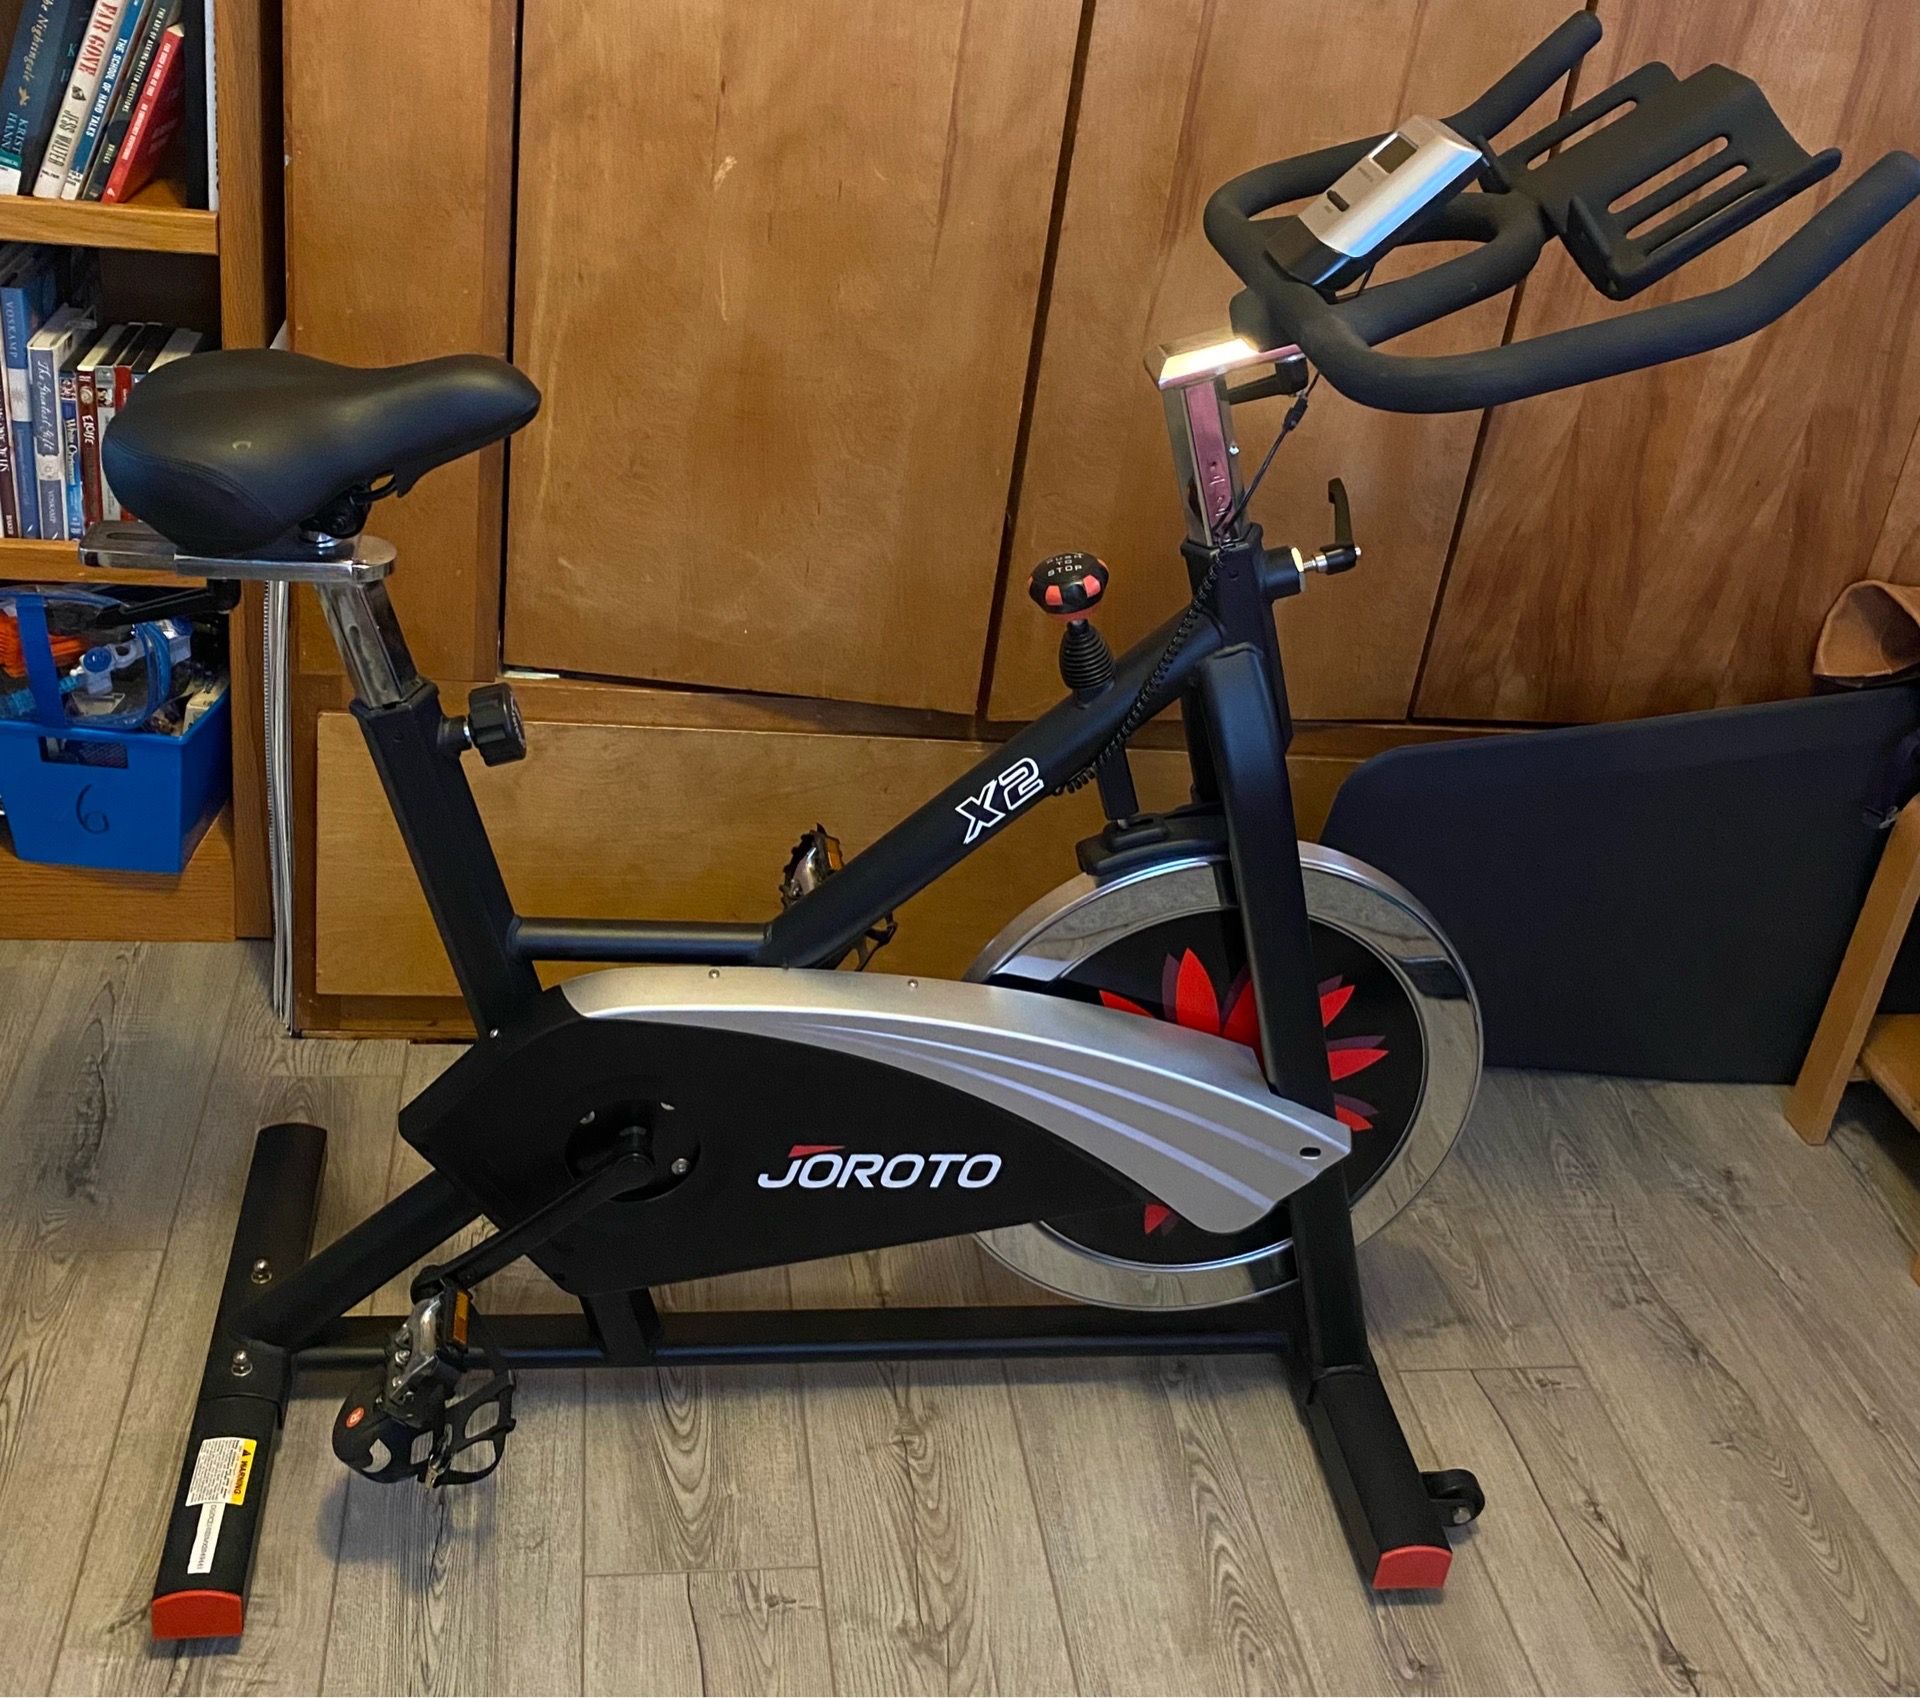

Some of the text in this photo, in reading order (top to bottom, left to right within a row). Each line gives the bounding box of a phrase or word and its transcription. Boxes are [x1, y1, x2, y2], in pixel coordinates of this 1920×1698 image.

[23, 13, 48, 82] Nightingale
[78, 2, 118, 76] FAR GONE
[141, 40, 154, 60] ASKING
[85, 37, 128, 137] THE SCHOOL OF HARD TALKS
[133, 61, 146, 82] BETTER
[122, 82, 139, 112] QUESTIONS
[59, 110, 79, 133] JESS
[48, 134, 72, 167] WALTER
[6, 301, 18, 358] VOSKAMP
[37, 360, 55, 450] The Greatest Gift
[82, 414, 96, 445] ELOISE
[1047, 565, 1083, 577] STOP
[75, 783, 110, 834] 6
[954, 757, 1045, 845] X2
[757, 1152, 1002, 1188] JOROTO
[233, 1460, 248, 1495] WARNING
